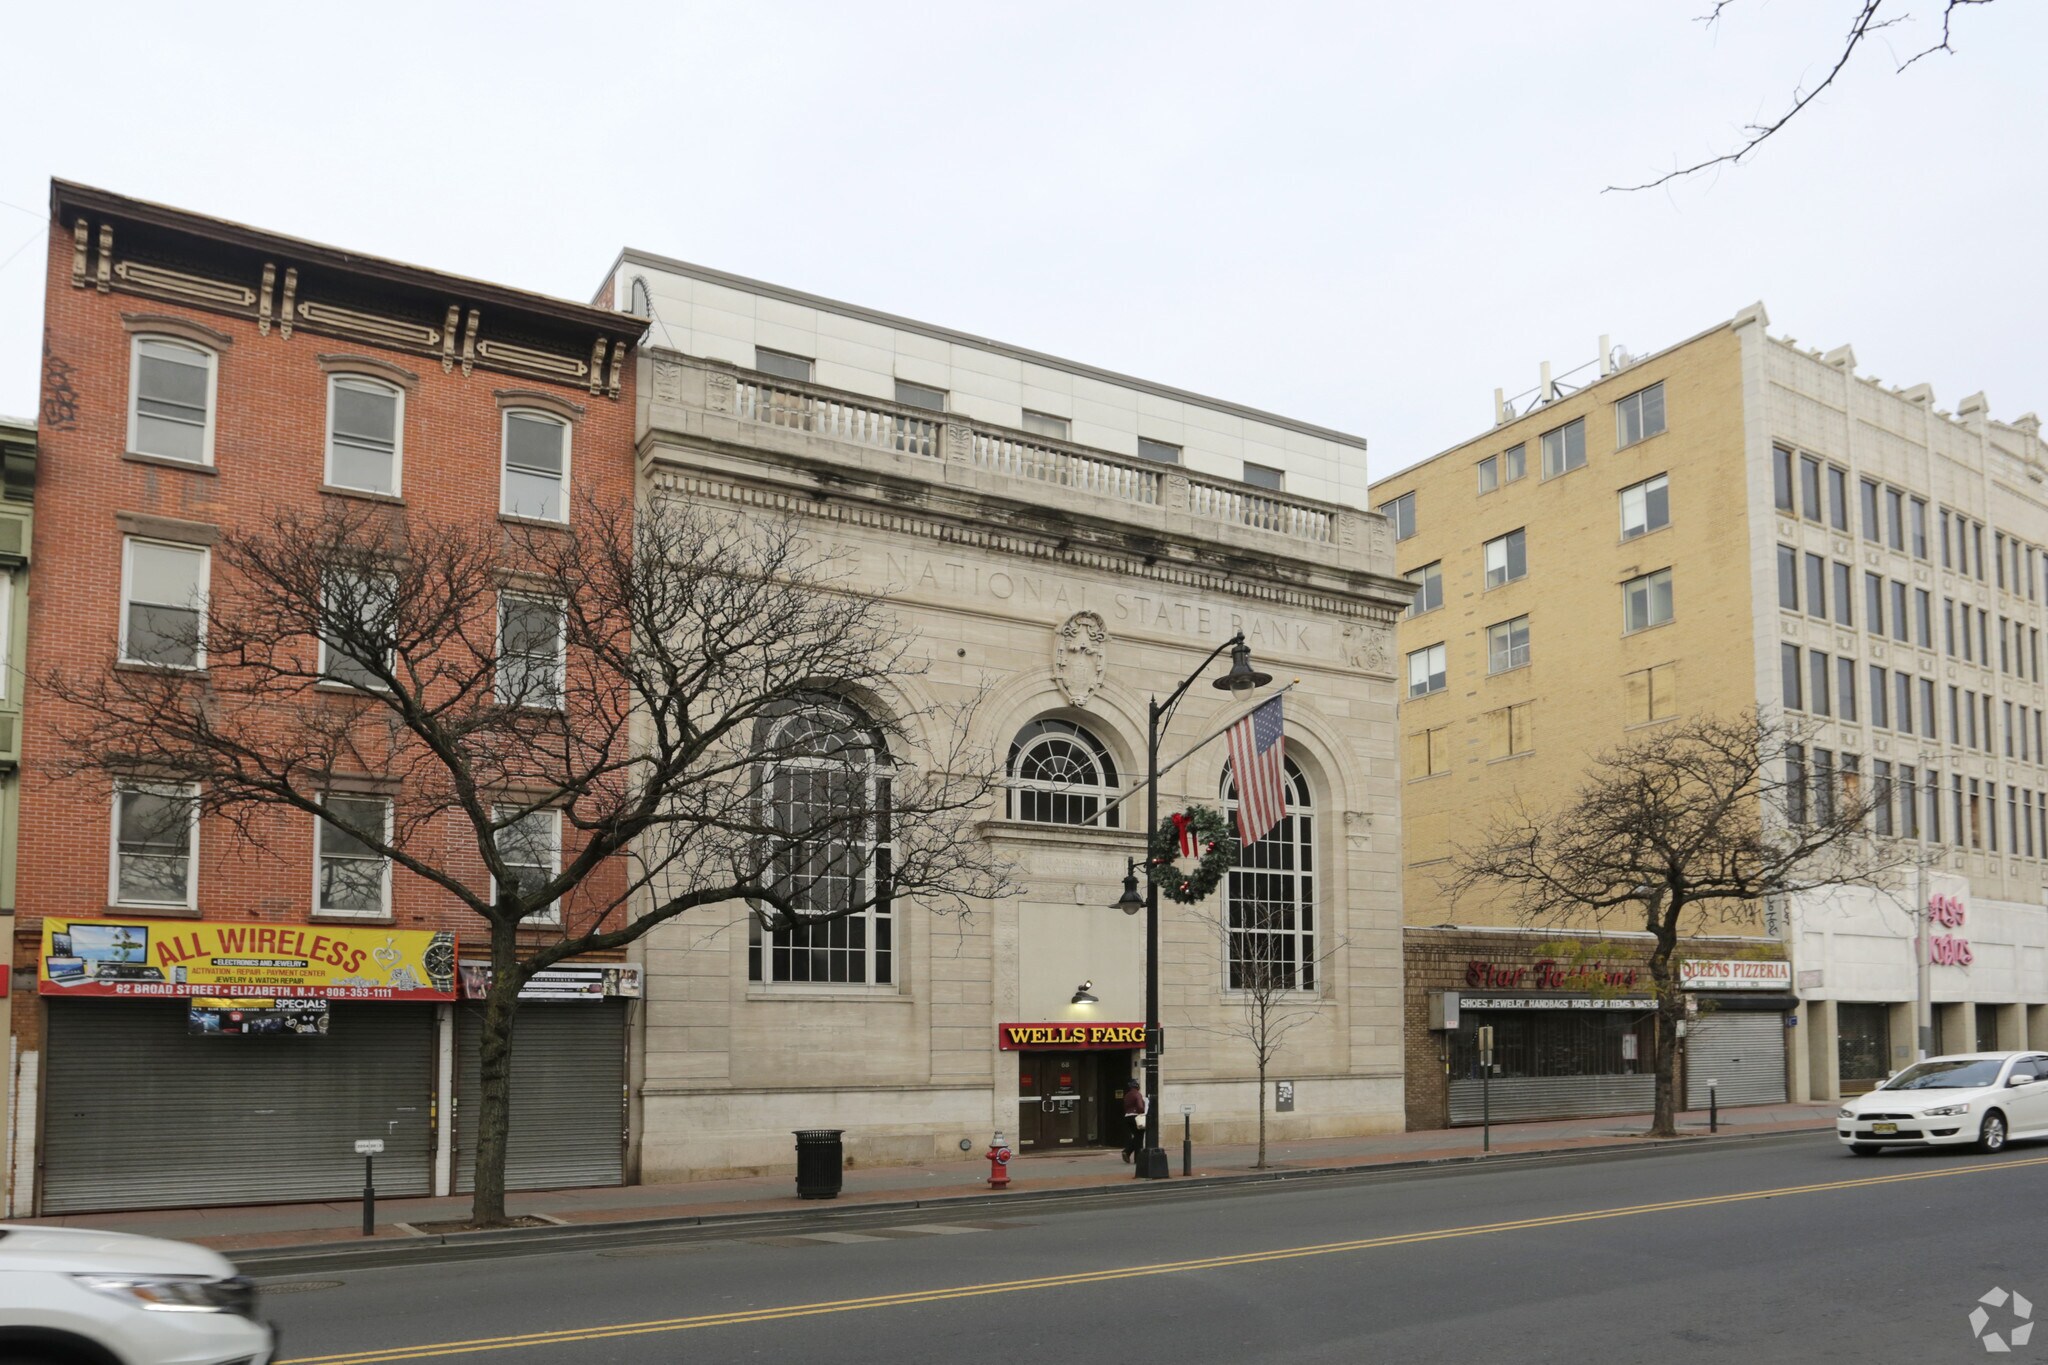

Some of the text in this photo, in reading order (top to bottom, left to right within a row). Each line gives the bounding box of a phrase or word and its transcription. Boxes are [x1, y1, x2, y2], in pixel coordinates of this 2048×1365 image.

[1114, 593, 1211, 634] STATE
[1231, 613, 1311, 651] BANK
[156, 928, 367, 973] ALL WIRELESS
[217, 959, 259, 967] ELECTRONICS
[192, 967, 231, 975] ACTIVATION
[1466, 959, 1637, 989] Star Fahns
[1682, 962, 1730, 978] QUEENS
[1733, 963, 1788, 979] PIZZERIA
[280, 977, 304, 985] REPAIR
[116, 984, 392, 998] 62 BROAD STREET ELIZABETH, N.J. 908-353-1111
[275, 999, 327, 1009] SPECIALS
[1460, 999, 1488, 1008] SHOES
[1489, 999, 1525, 1008] JEWELRY
[1528, 999, 1569, 1008] HANDBAGS
[1008, 1026, 1147, 1044] WELLS FARG
